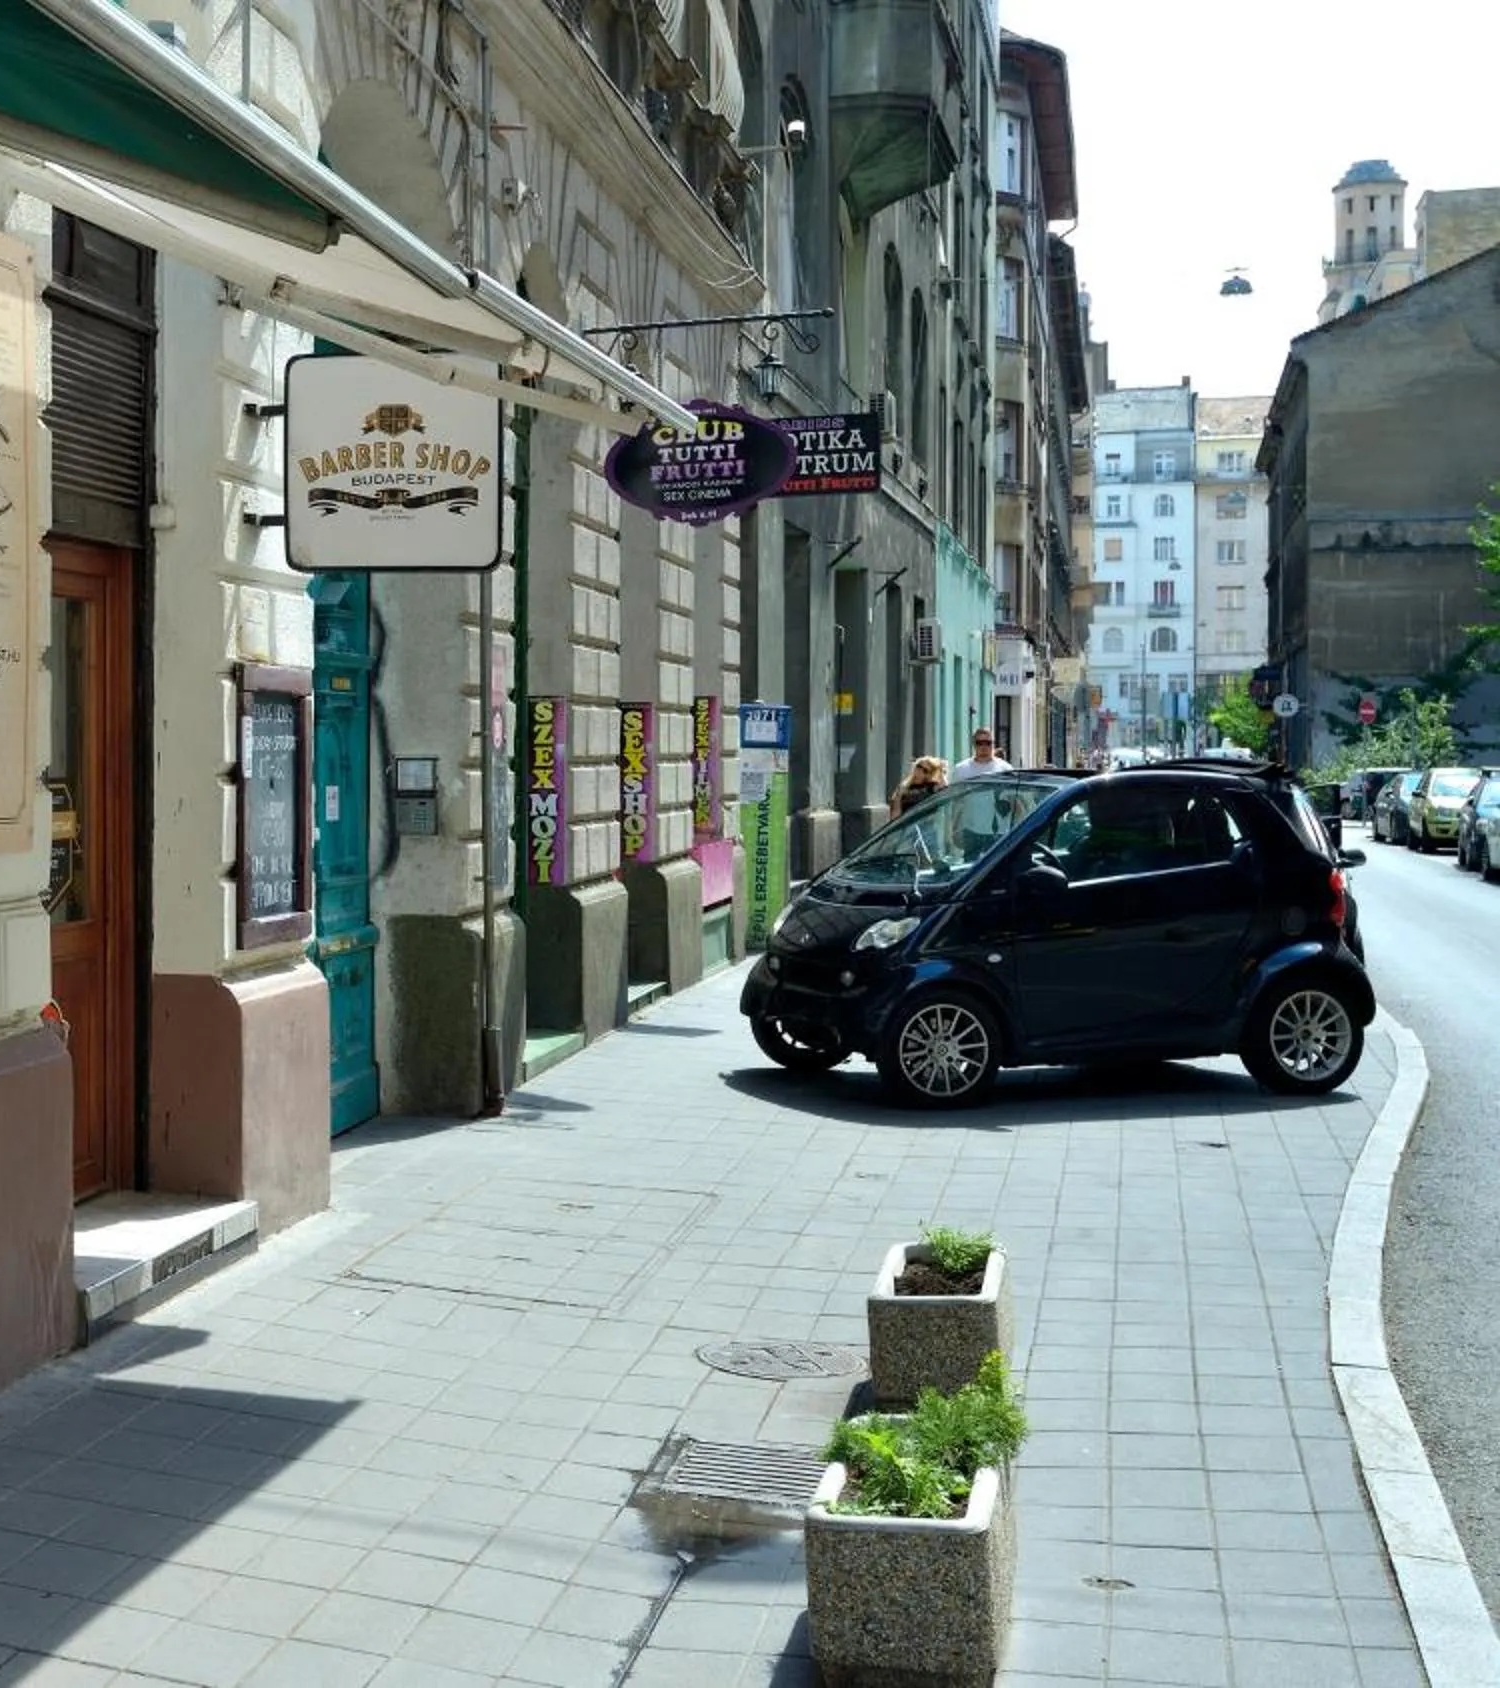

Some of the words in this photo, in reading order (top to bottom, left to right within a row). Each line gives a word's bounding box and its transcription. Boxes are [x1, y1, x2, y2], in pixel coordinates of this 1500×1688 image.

[652, 420, 745, 446] CLUB
[299, 441, 405, 483] BARBER
[415, 443, 491, 481] SHOP
[657, 443, 737, 463] TUTTI
[795, 451, 876, 475] TRUM
[351, 473, 436, 487] BUDAPEST
[650, 460, 745, 482] FRUTTI
[663, 490, 685, 502] SEX
[687, 487, 732, 501] CINEMA
[623, 711, 649, 856] SEXSHOP
[752, 788, 771, 902] ERZSÉBETVÁR
